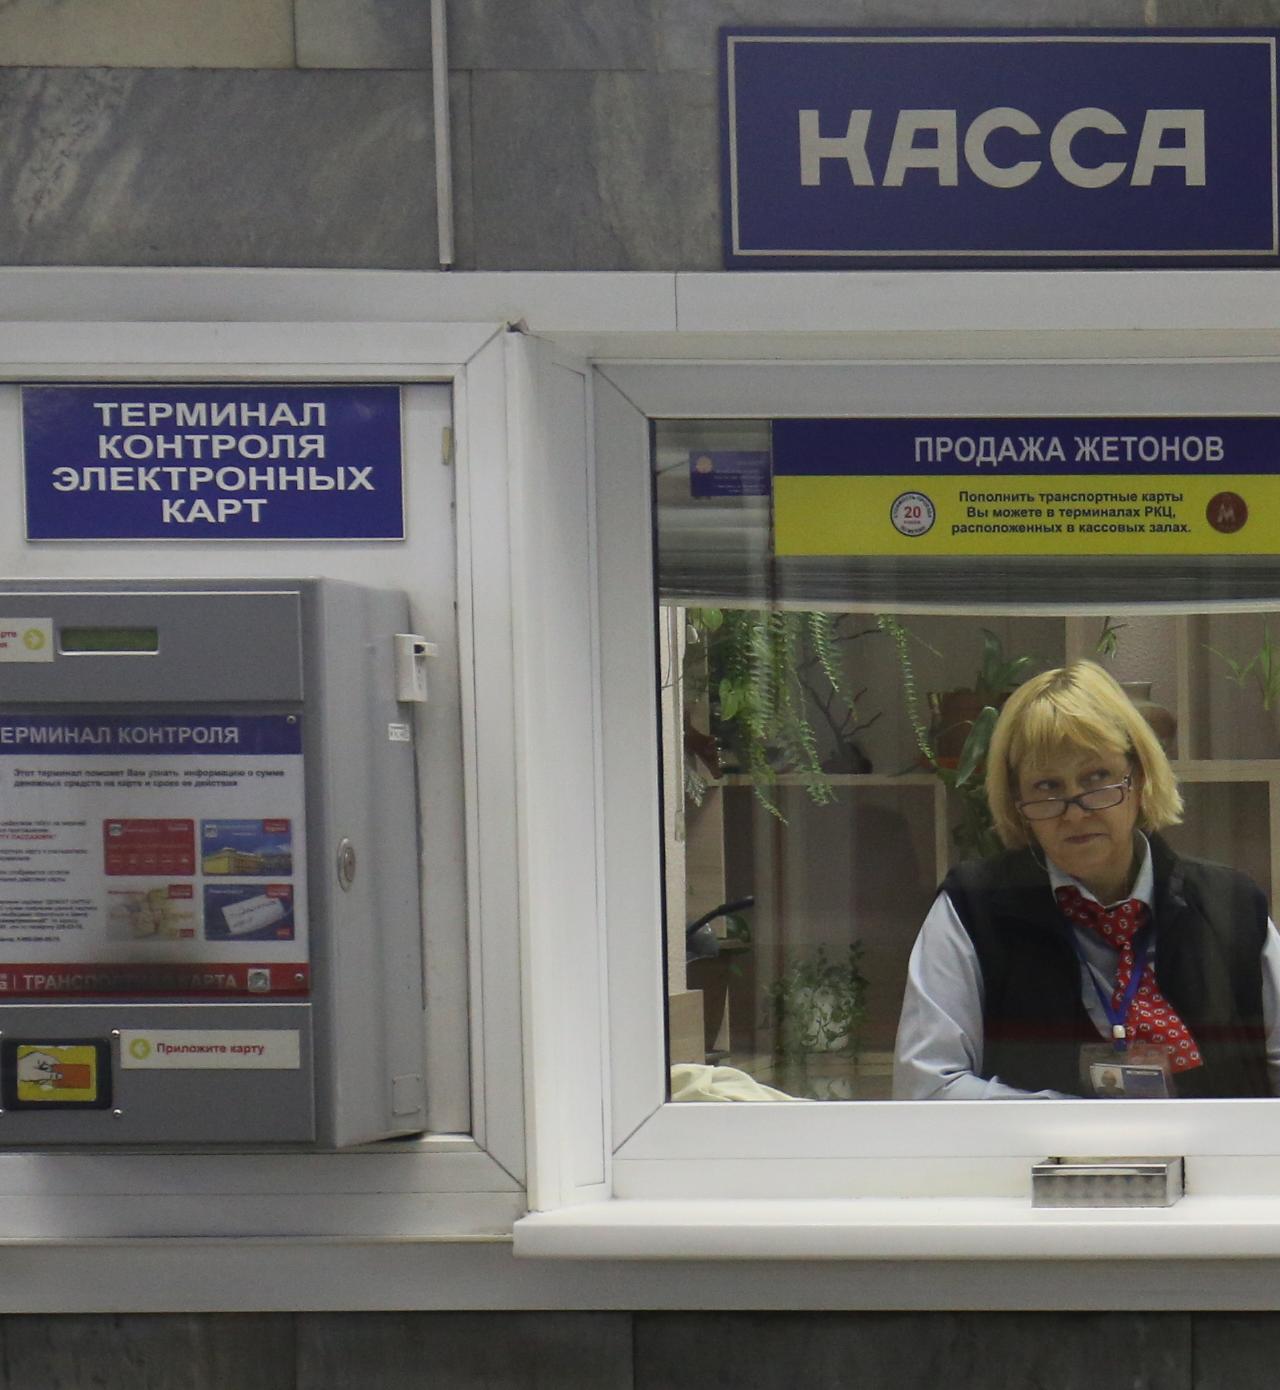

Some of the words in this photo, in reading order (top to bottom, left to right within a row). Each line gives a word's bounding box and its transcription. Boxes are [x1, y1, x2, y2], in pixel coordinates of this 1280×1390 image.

[799, 107, 1206, 188] КАССА
[94, 402, 326, 427] ТЕРМИНАЛ
[99, 434, 325, 459] КОНТРОЛЯ
[915, 436, 1065, 465] ПРОДАЖА
[1074, 436, 1224, 462] ЖЕТОНОВ
[52, 466, 375, 491] ЭЛЕКТРОННЫХ
[959, 492, 1035, 503] Пополнить
[1039, 492, 1137, 505] транспортные
[1142, 492, 1183, 504] карты
[162, 498, 268, 523] КАРТ
[904, 506, 921, 518] 20
[967, 507, 989, 518] Вы
[993, 508, 1043, 518] можете
[1047, 509, 1055, 518] в
[1059, 508, 1140, 518] терминалах
[1145, 507, 1176, 519] РКЦ,
[952, 524, 1062, 535] расположенных
[1067, 525, 1074, 534] в
[1079, 525, 1145, 534] кассовых
[1149, 524, 1191, 534] залах.
[0, 727, 111, 744] ЕРМИНАЛ
[119, 727, 240, 744] КОНТРОЛЯ
[156, 1042, 227, 1054] Приложите
[230, 1044, 265, 1056] карту
